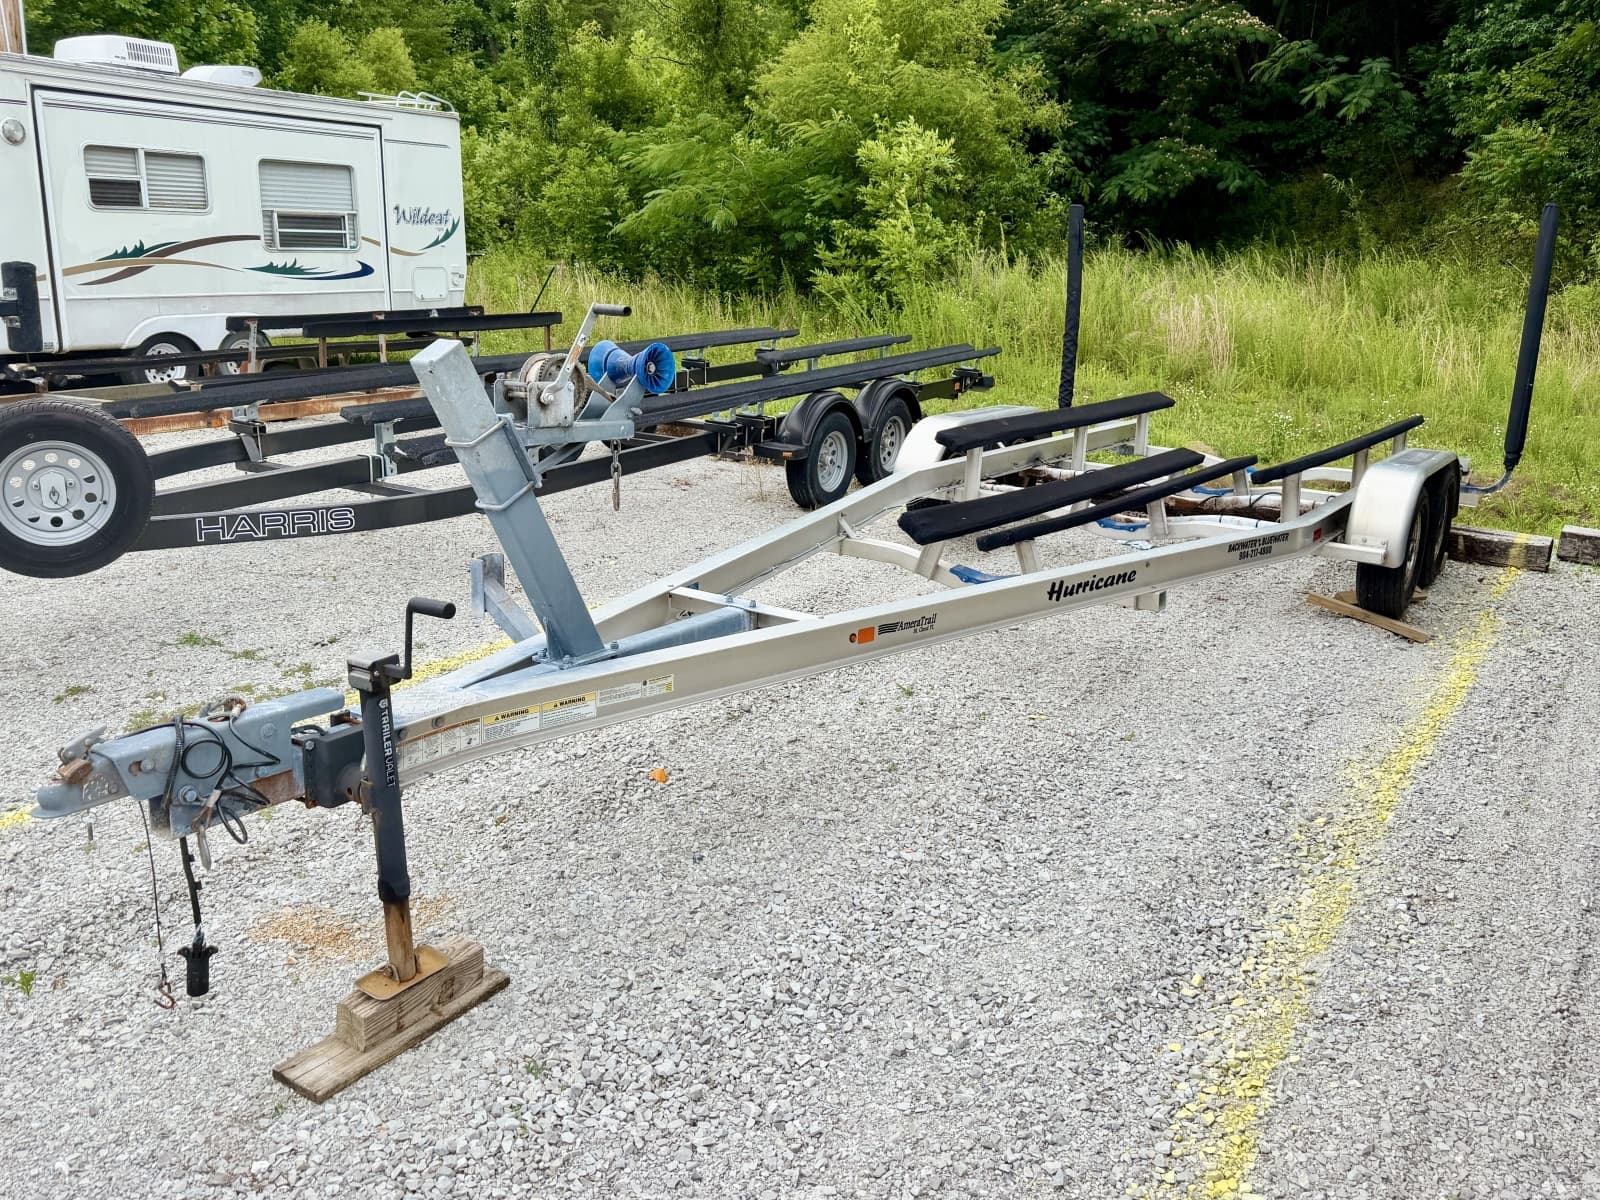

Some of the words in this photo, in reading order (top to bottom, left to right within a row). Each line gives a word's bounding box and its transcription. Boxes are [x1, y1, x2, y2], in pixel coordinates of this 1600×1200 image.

[393, 204, 450, 225] Wildcat
[196, 507, 355, 542] HARRIS
[1047, 570, 1137, 602] Hurricane
[897, 613, 937, 632] AmeraTrail
[559, 696, 586, 707] WARNING
[501, 708, 530, 720] WARNING
